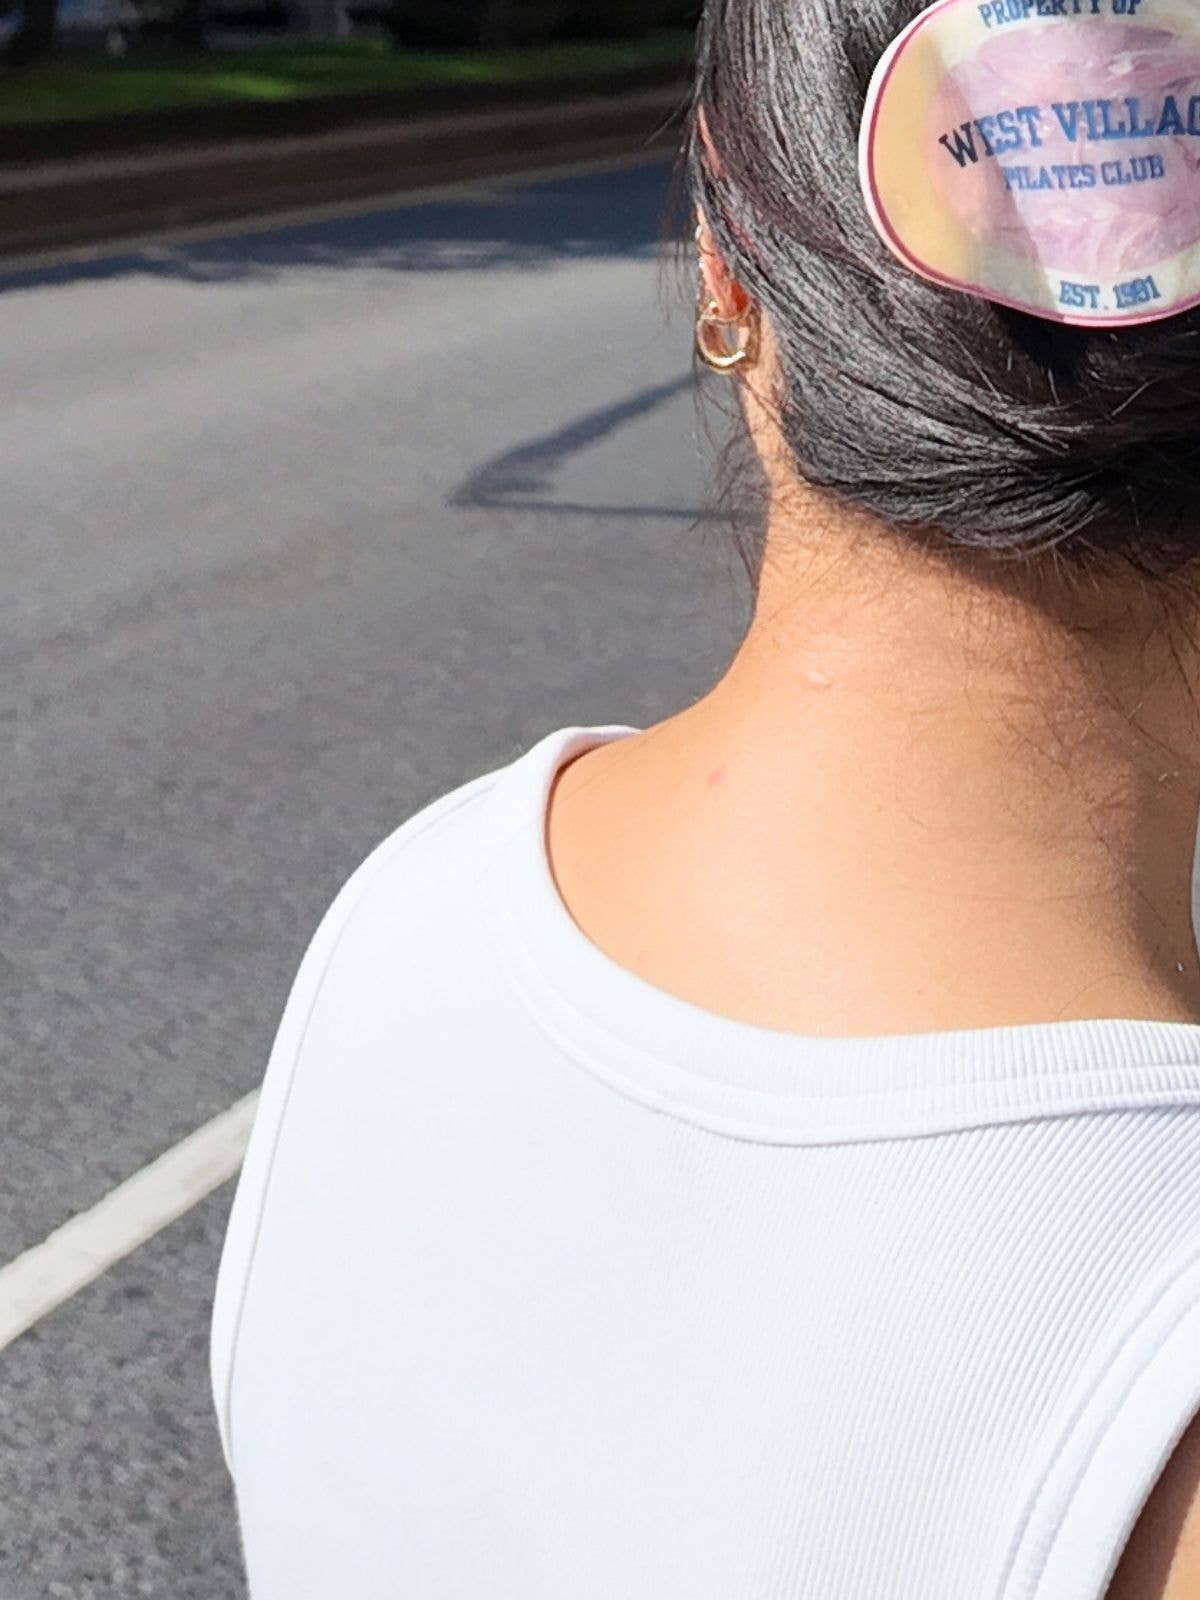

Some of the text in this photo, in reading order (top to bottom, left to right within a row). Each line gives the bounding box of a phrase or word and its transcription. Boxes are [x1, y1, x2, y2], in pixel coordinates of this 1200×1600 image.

[939, 106, 1042, 167] WEST
[1003, 154, 1165, 190] PILATES CLUB
